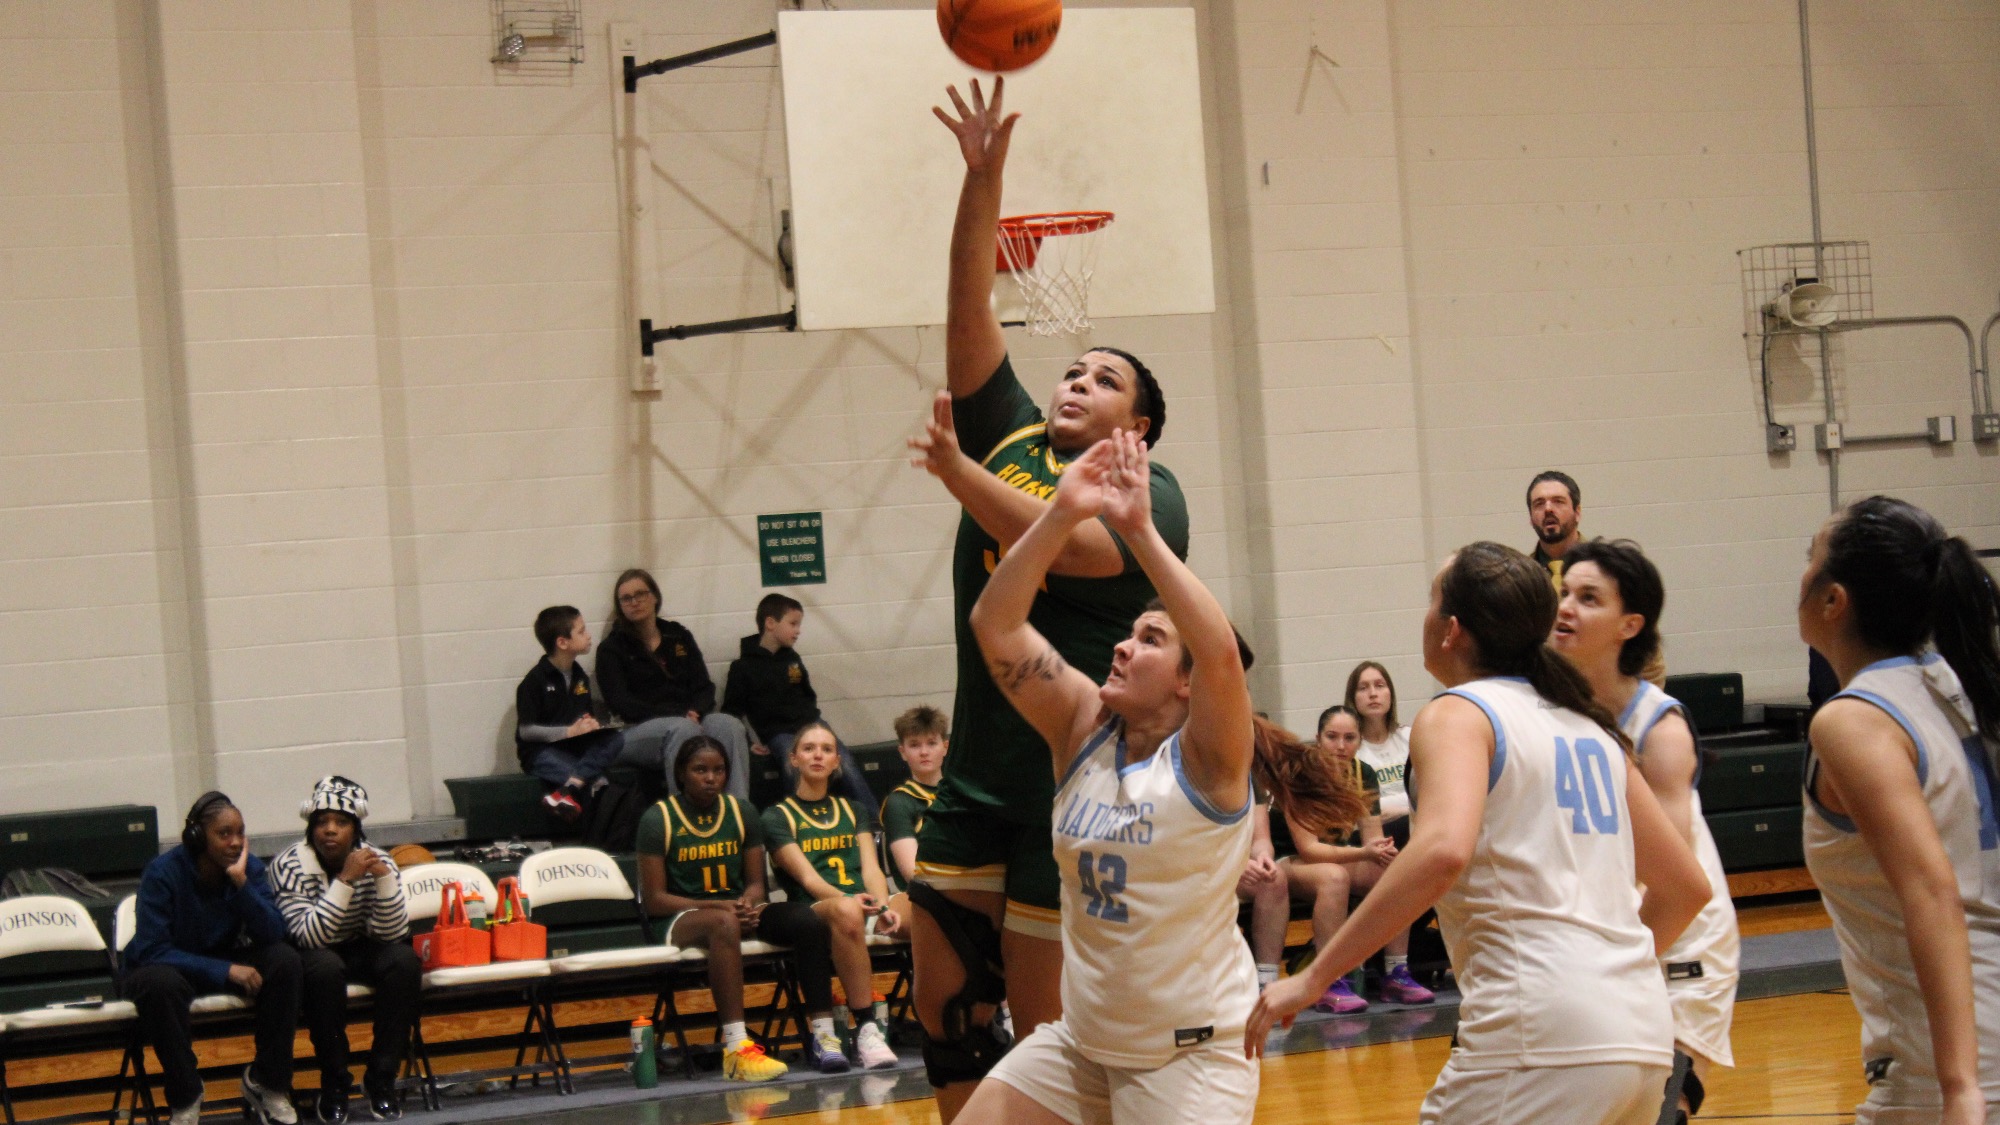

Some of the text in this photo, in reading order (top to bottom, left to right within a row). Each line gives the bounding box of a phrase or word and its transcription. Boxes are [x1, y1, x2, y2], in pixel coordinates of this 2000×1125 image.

[996, 463, 1061, 503] HORN
[760, 522, 769, 530] DO
[771, 521, 784, 529] NOT
[787, 520, 797, 528] SIT
[799, 520, 809, 528] ON
[766, 536, 817, 547] USE BLEACHERS
[770, 553, 816, 564] WHEN CLOSED
[1376, 764, 1404, 784] OME
[1554, 736, 1618, 835] 40
[677, 840, 738, 862] HORNETS
[536, 863, 609, 887] JOHNSON
[701, 864, 731, 893] 11
[828, 857, 855, 885] 2
[1077, 850, 1129, 924] 42
